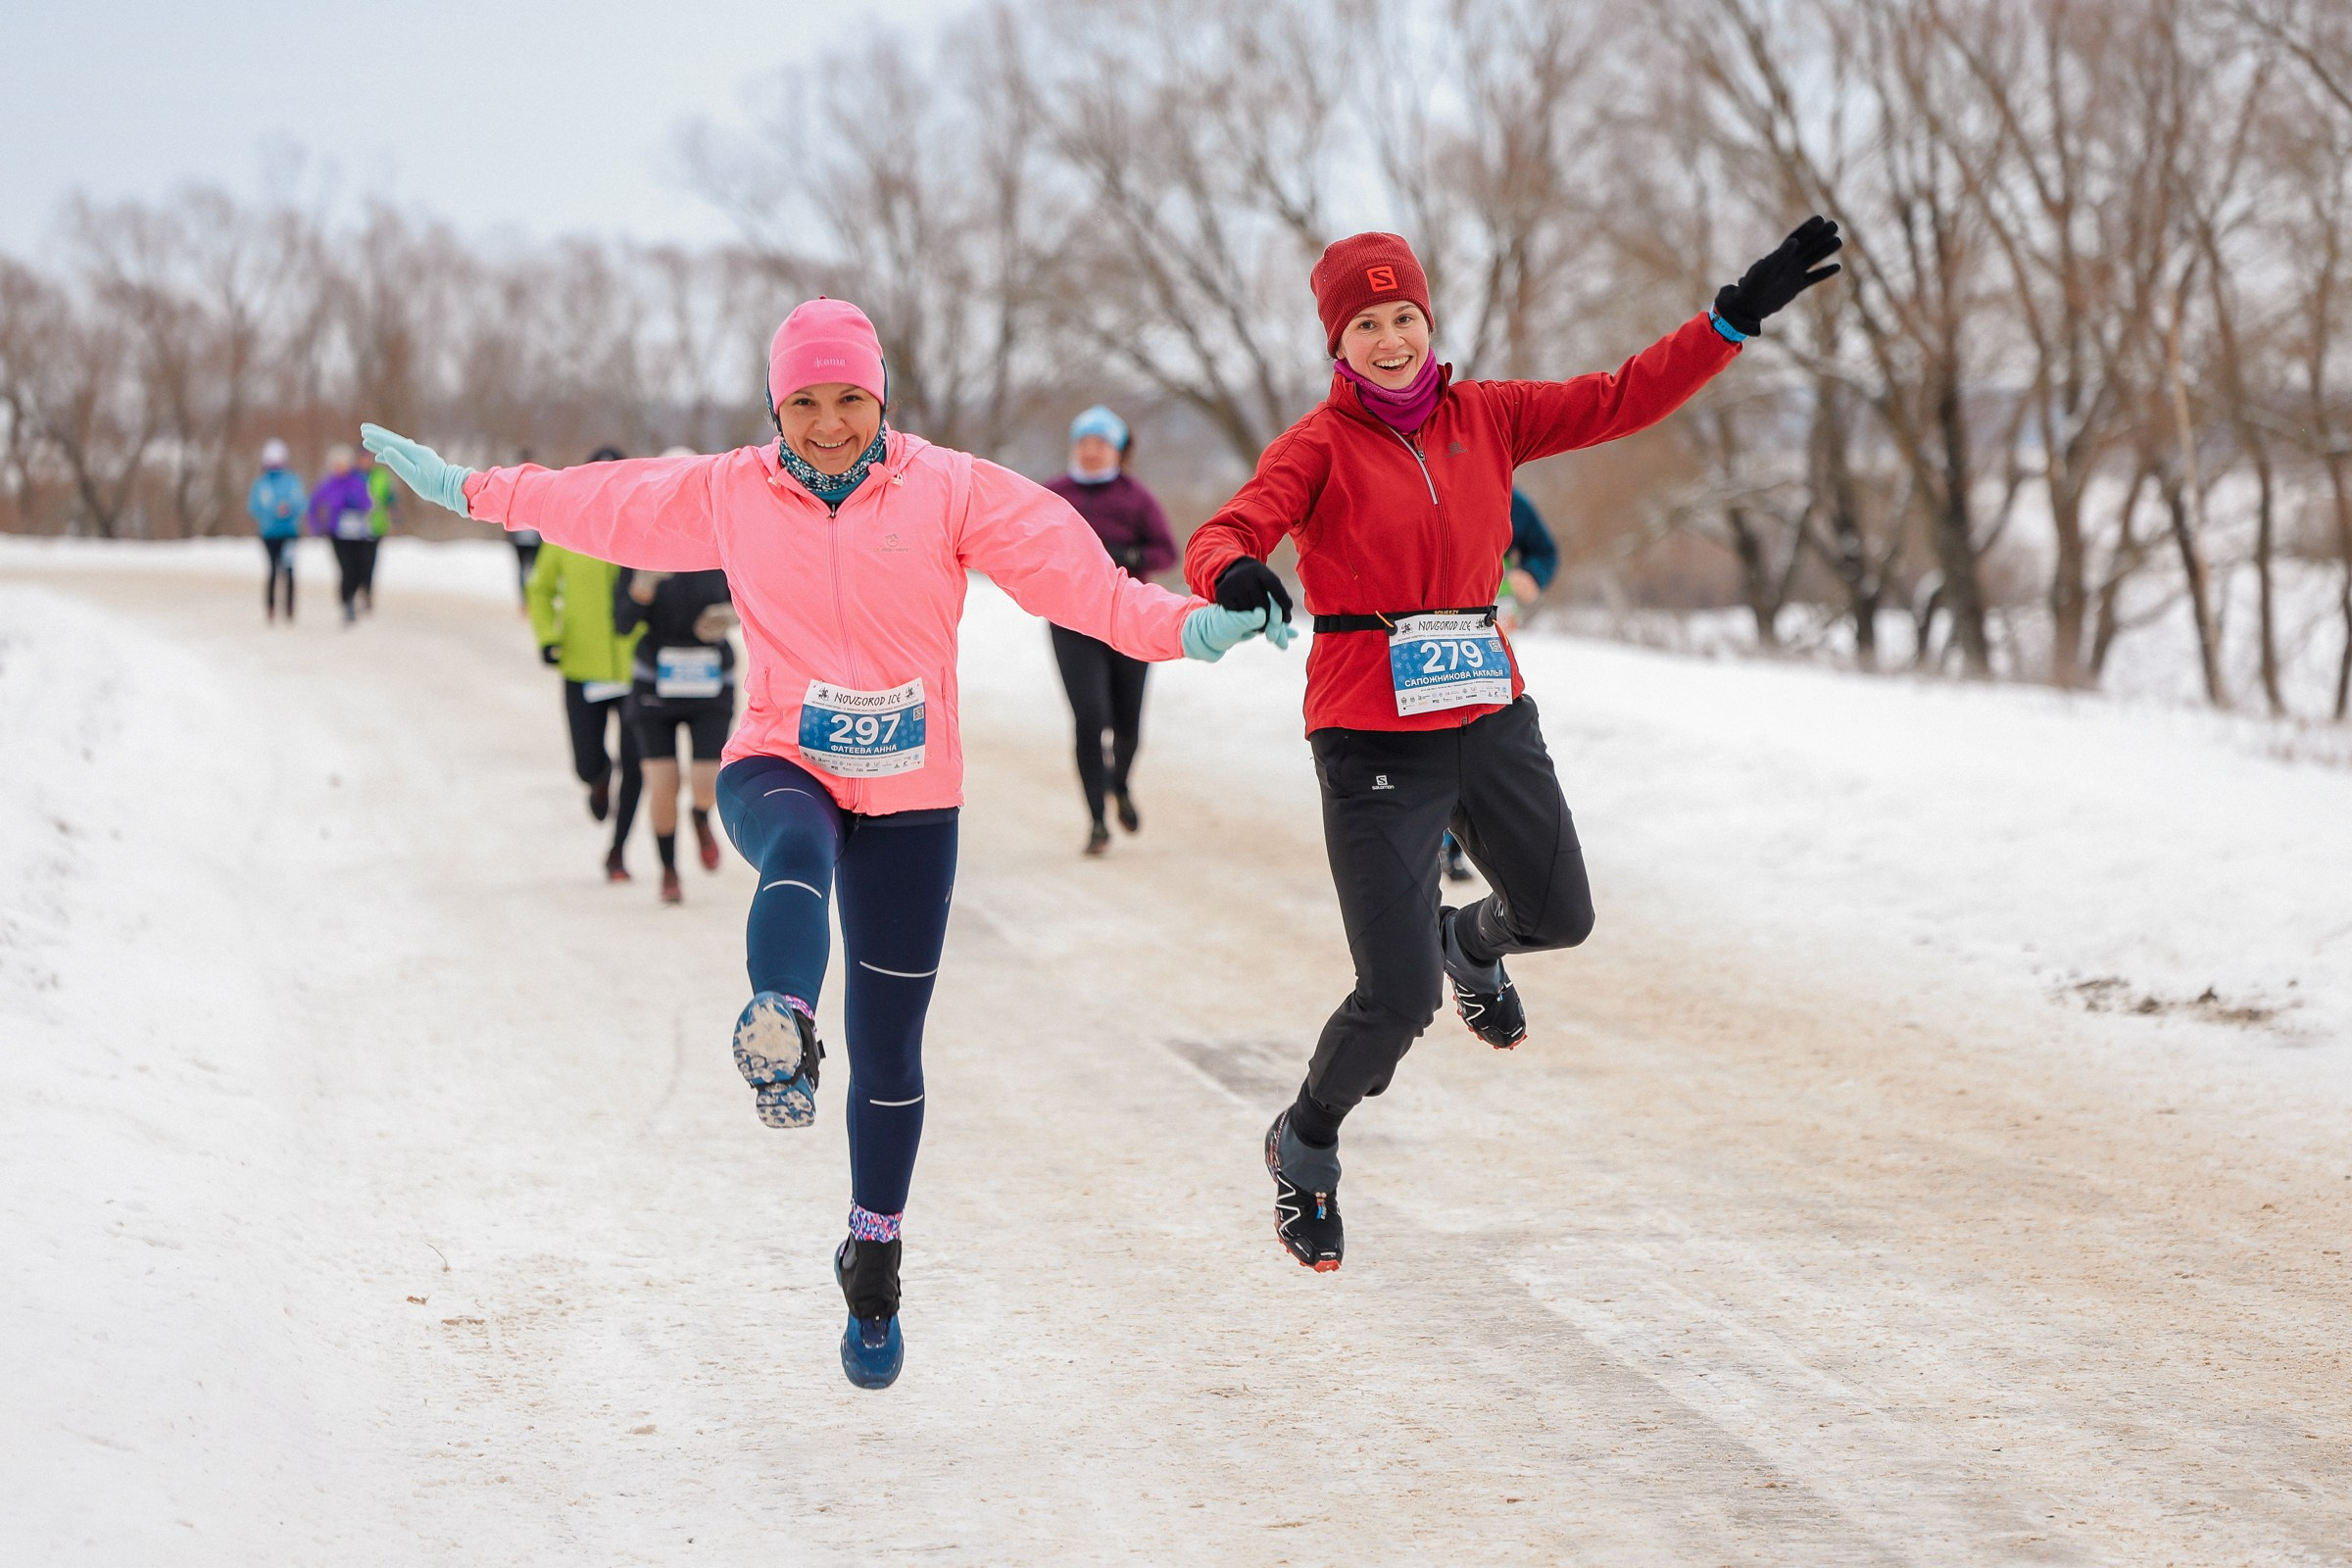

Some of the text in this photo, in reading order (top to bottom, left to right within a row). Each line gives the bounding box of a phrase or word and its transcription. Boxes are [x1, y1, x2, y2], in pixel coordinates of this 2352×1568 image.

[1418, 620, 1472, 632] NOVGOROD ICE
[1420, 640, 1485, 674] 279
[1404, 671, 1472, 688] САПОЖНИКОВА
[1473, 669, 1504, 678] НАТАЛЬЯ
[834, 692, 887, 707] NOVGOROD
[888, 692, 901, 705] ICE
[829, 712, 901, 746] 297
[830, 744, 898, 755] ФАТЕЕВА АННА
